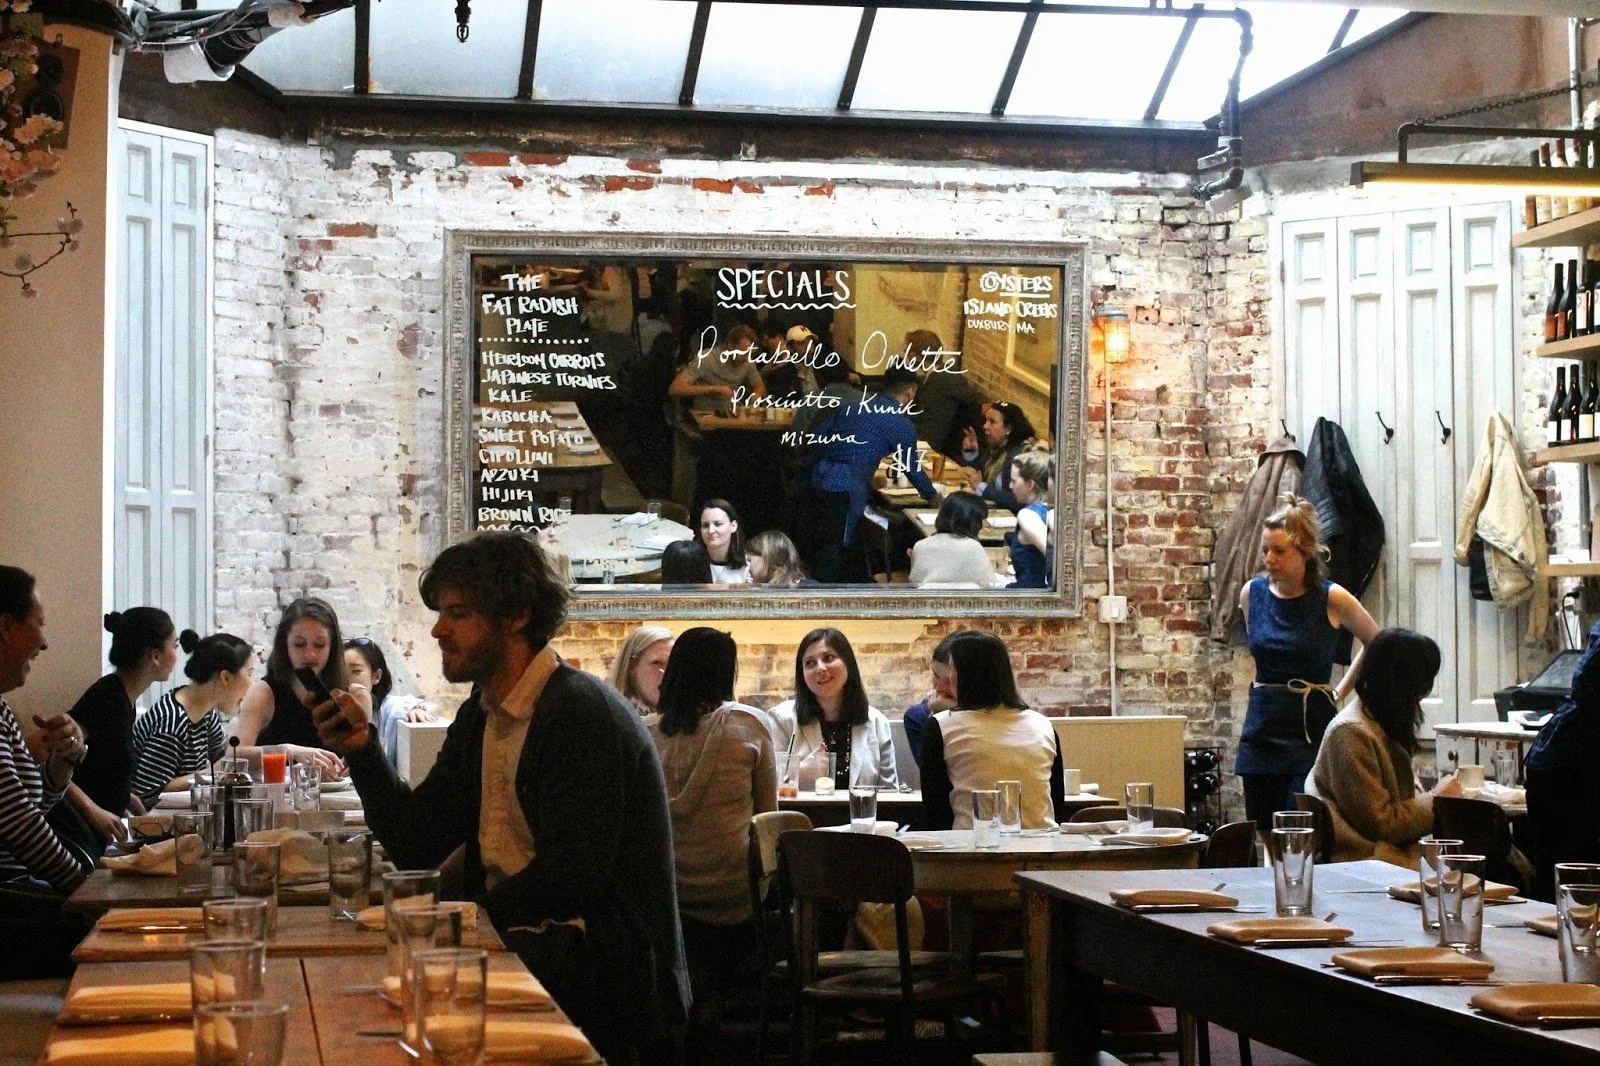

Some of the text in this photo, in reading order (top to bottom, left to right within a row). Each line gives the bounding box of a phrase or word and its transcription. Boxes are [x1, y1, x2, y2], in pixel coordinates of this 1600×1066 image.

[500, 273, 543, 292] THE
[716, 267, 851, 301] SPECIALS
[980, 271, 1053, 293] OYSTERS
[481, 293, 579, 316] FAT RADISH
[963, 298, 1058, 318] ISLAND CREEKS
[505, 318, 549, 337] PLATE
[1016, 321, 1036, 334] MA
[697, 325, 841, 370] Portabello
[481, 350, 607, 370] HEIRLOOM CARROTS
[481, 368, 617, 390] JAPANESE TURNIPS
[488, 388, 533, 403] KALE
[857, 385, 924, 416] Kunik
[481, 407, 552, 424] KABOCHA
[478, 426, 584, 448] SWEET POTATO
[780, 430, 869, 447] Mizuna
[478, 448, 554, 465] CIPOLLINI
[888, 443, 929, 478] $17
[480, 467, 539, 483] ADZUKI
[482, 486, 534, 503] HIJIKI
[477, 506, 573, 524] BROWN RICE
